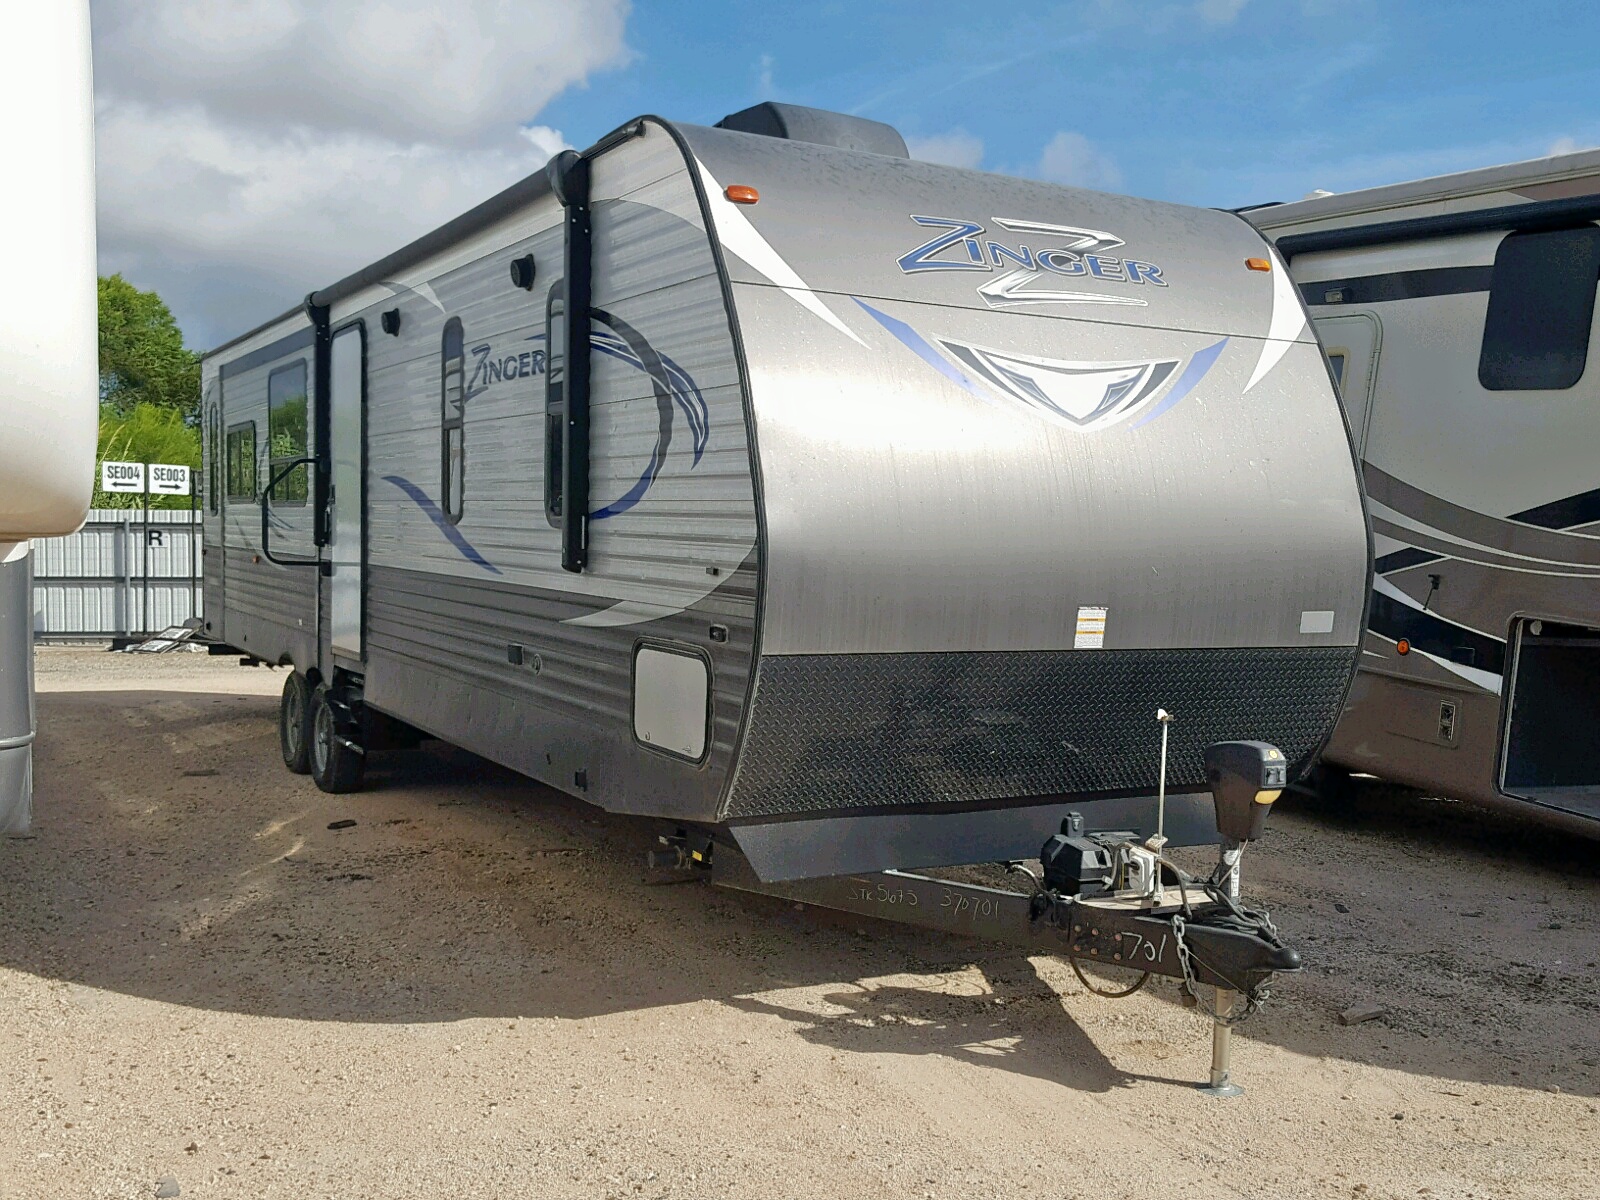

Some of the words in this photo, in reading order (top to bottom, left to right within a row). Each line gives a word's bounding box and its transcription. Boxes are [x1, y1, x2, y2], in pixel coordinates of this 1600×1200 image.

[895, 214, 1169, 287] ZINGER
[464, 343, 547, 404] ZINGER
[107, 465, 140, 480] SE004
[153, 467, 186, 482] SE003
[1121, 931, 1167, 963] 701
